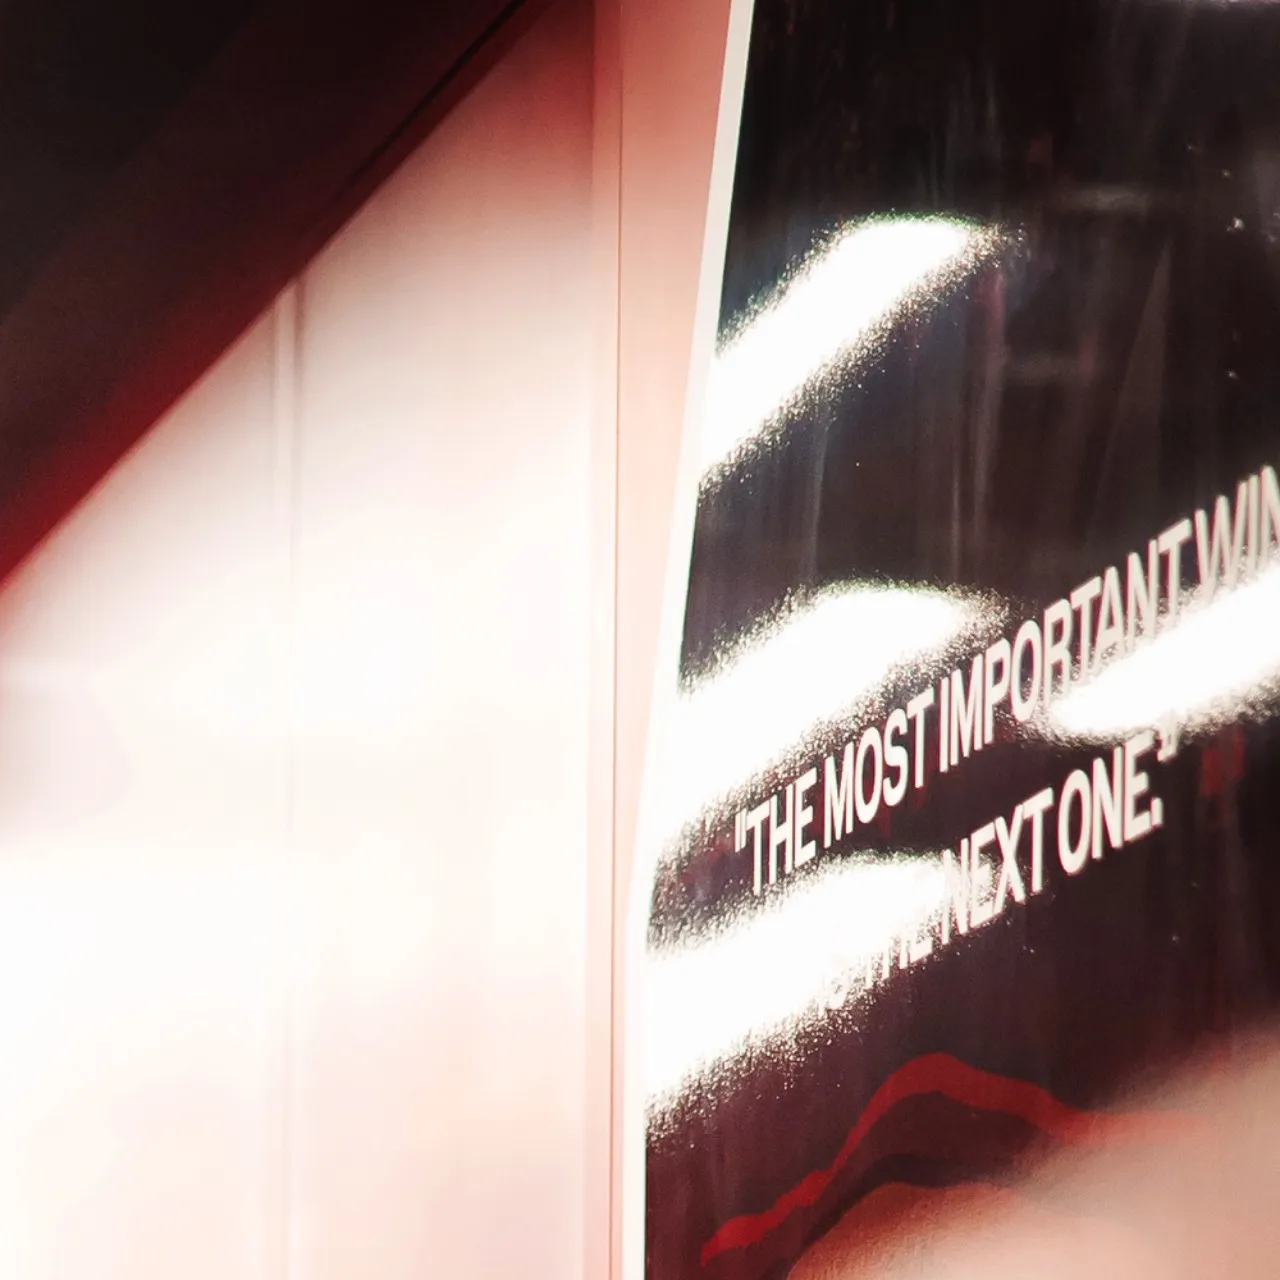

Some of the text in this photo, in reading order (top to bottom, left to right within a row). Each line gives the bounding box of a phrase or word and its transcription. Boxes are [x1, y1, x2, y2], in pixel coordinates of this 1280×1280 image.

[824, 687, 935, 849] MOST
[939, 518, 1193, 773] IMPORTANT
[942, 786, 1054, 946] NEXT
